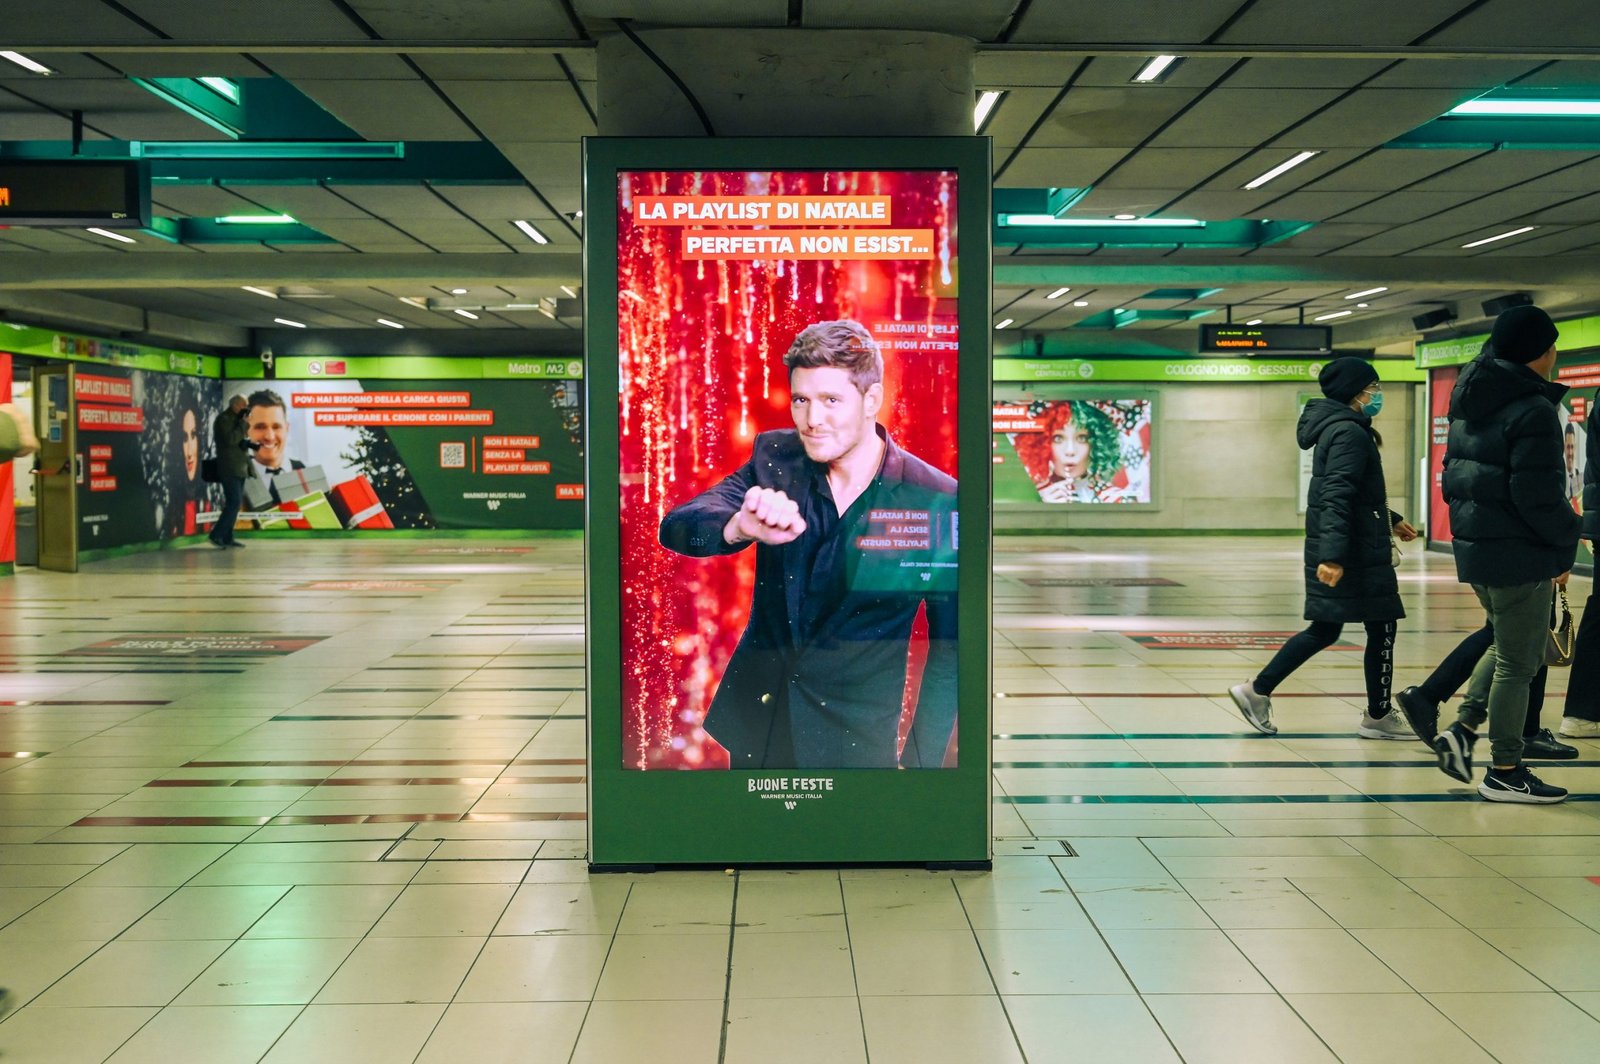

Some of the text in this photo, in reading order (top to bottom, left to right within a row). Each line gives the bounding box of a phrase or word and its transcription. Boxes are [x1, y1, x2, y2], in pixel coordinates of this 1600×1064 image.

[639, 202, 885, 220] LA PLAYLIST DI NATALE
[686, 236, 929, 254] PERFETTA NON ESIST...
[508, 362, 564, 374] Metro M2
[1165, 364, 1218, 376] COLOGNO
[1219, 364, 1251, 376] NORD
[1257, 364, 1306, 376] GESSATE
[294, 395, 467, 404] POV: HAI BISOGNO DELLA CARICA GIUSTA
[317, 413, 335, 422] PER
[336, 413, 381, 422] SUPERARE
[382, 413, 390, 422] IL
[391, 413, 427, 422] CENONE
[428, 413, 448, 422] CON
[454, 413, 491, 422] PARENTI
[484, 438, 502, 446] NON
[510, 438, 537, 446] NATALE
[485, 451, 522, 459] SENZA LA
[485, 464, 548, 472] PLAYLIST GIUSTA
[559, 487, 574, 496] MA
[748, 777, 834, 792] BUONE FESTE
